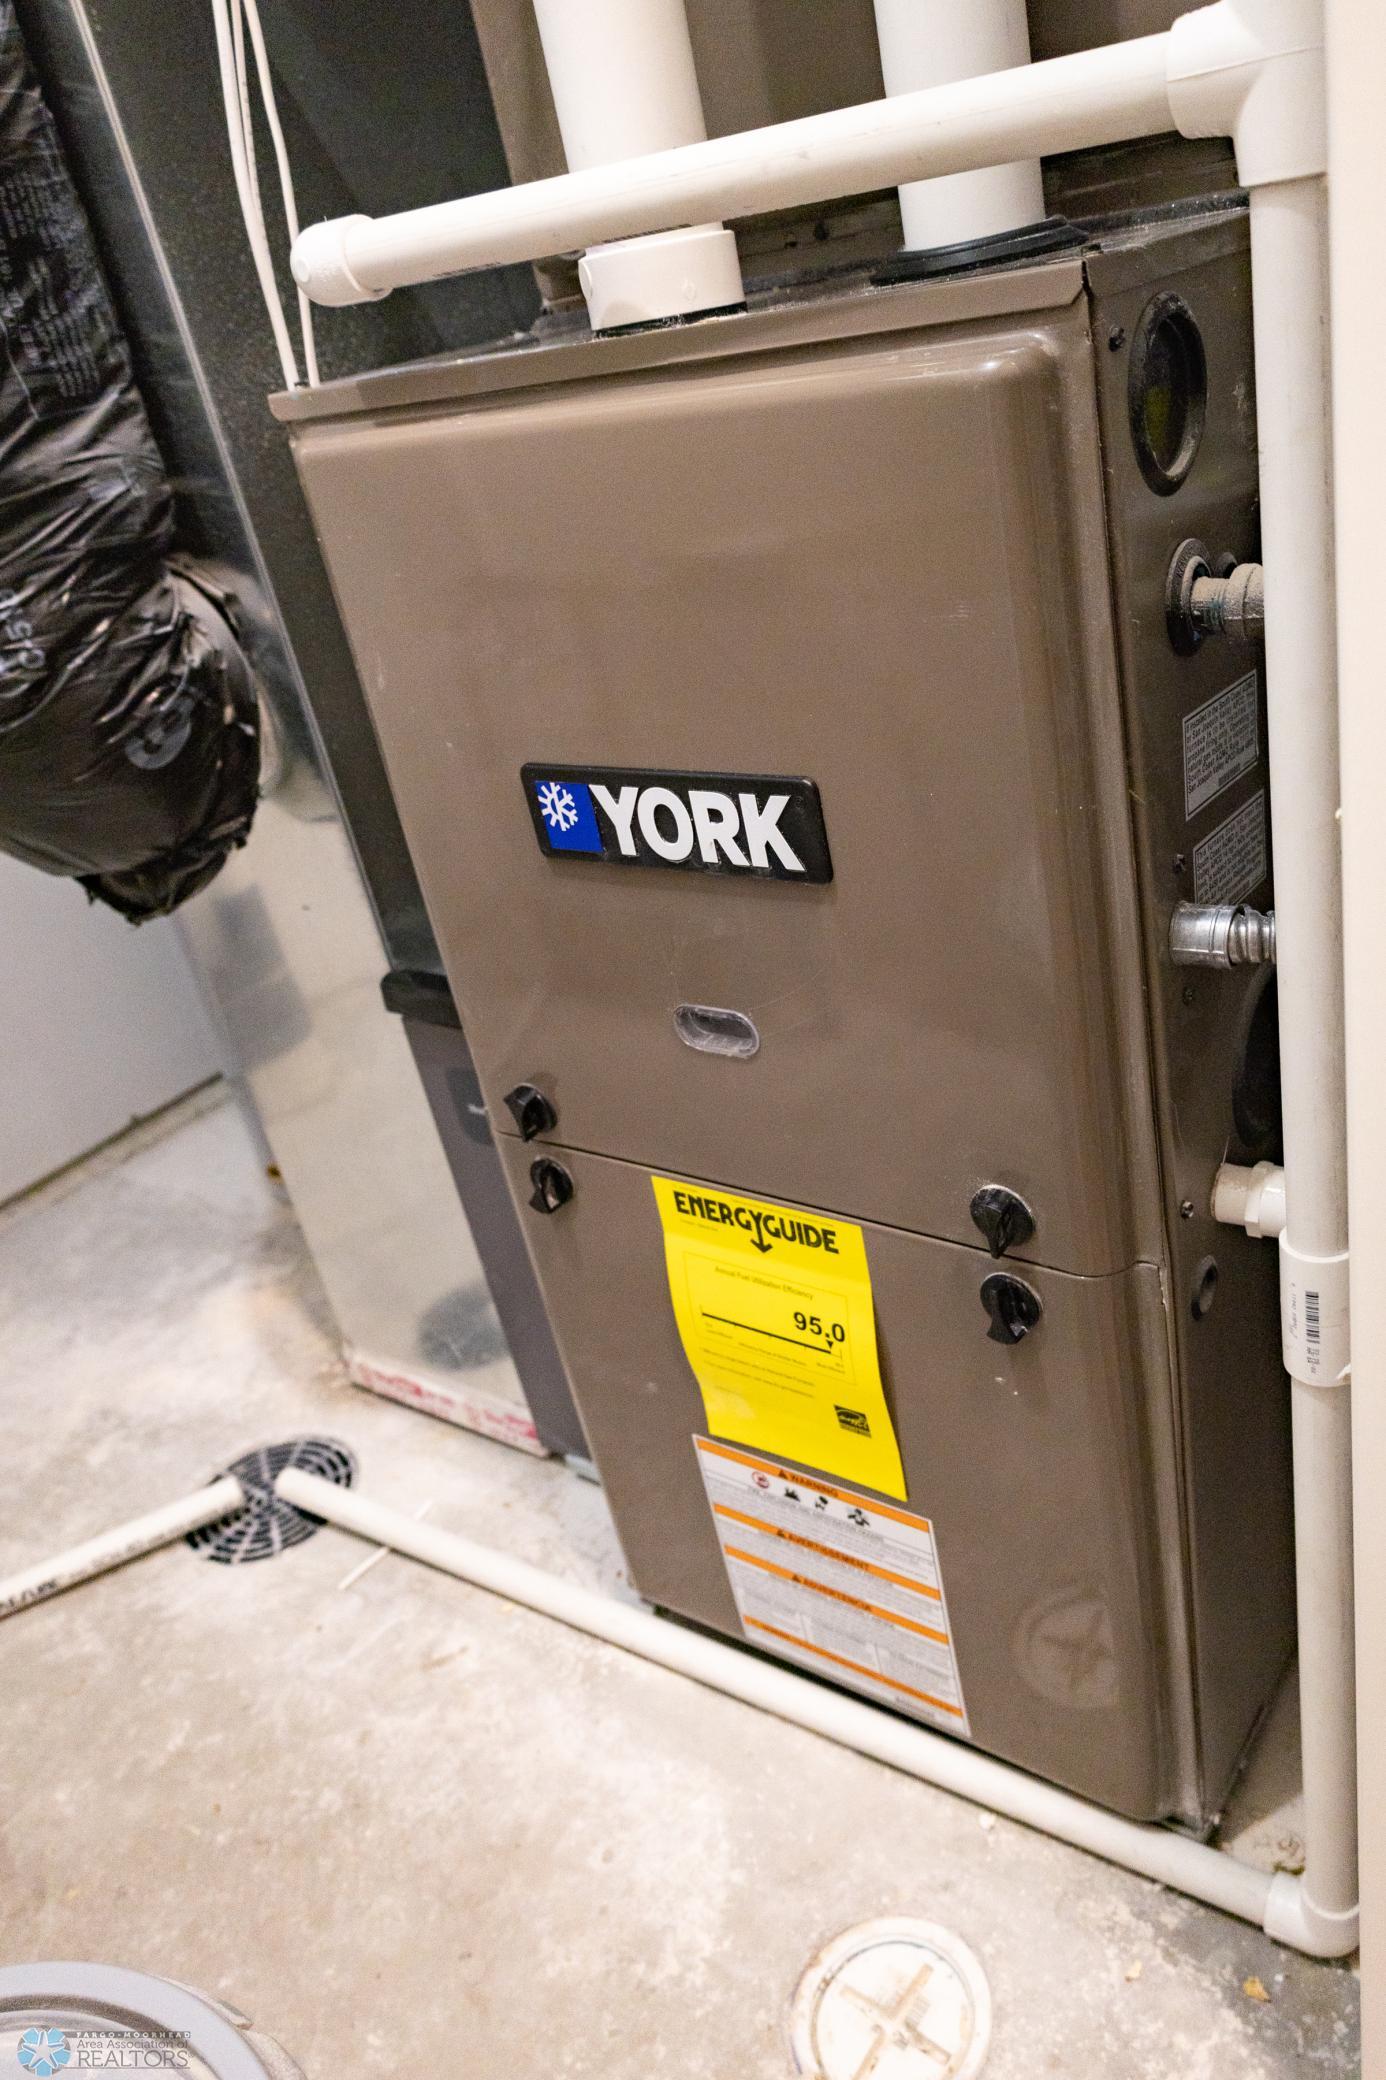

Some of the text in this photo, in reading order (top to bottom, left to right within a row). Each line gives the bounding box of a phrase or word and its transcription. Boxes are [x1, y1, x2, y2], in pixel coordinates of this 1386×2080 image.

[588, 783, 806, 872] YORK
[793, 1311, 846, 1343] 95.0
[790, 1475, 840, 1499] WARNING
